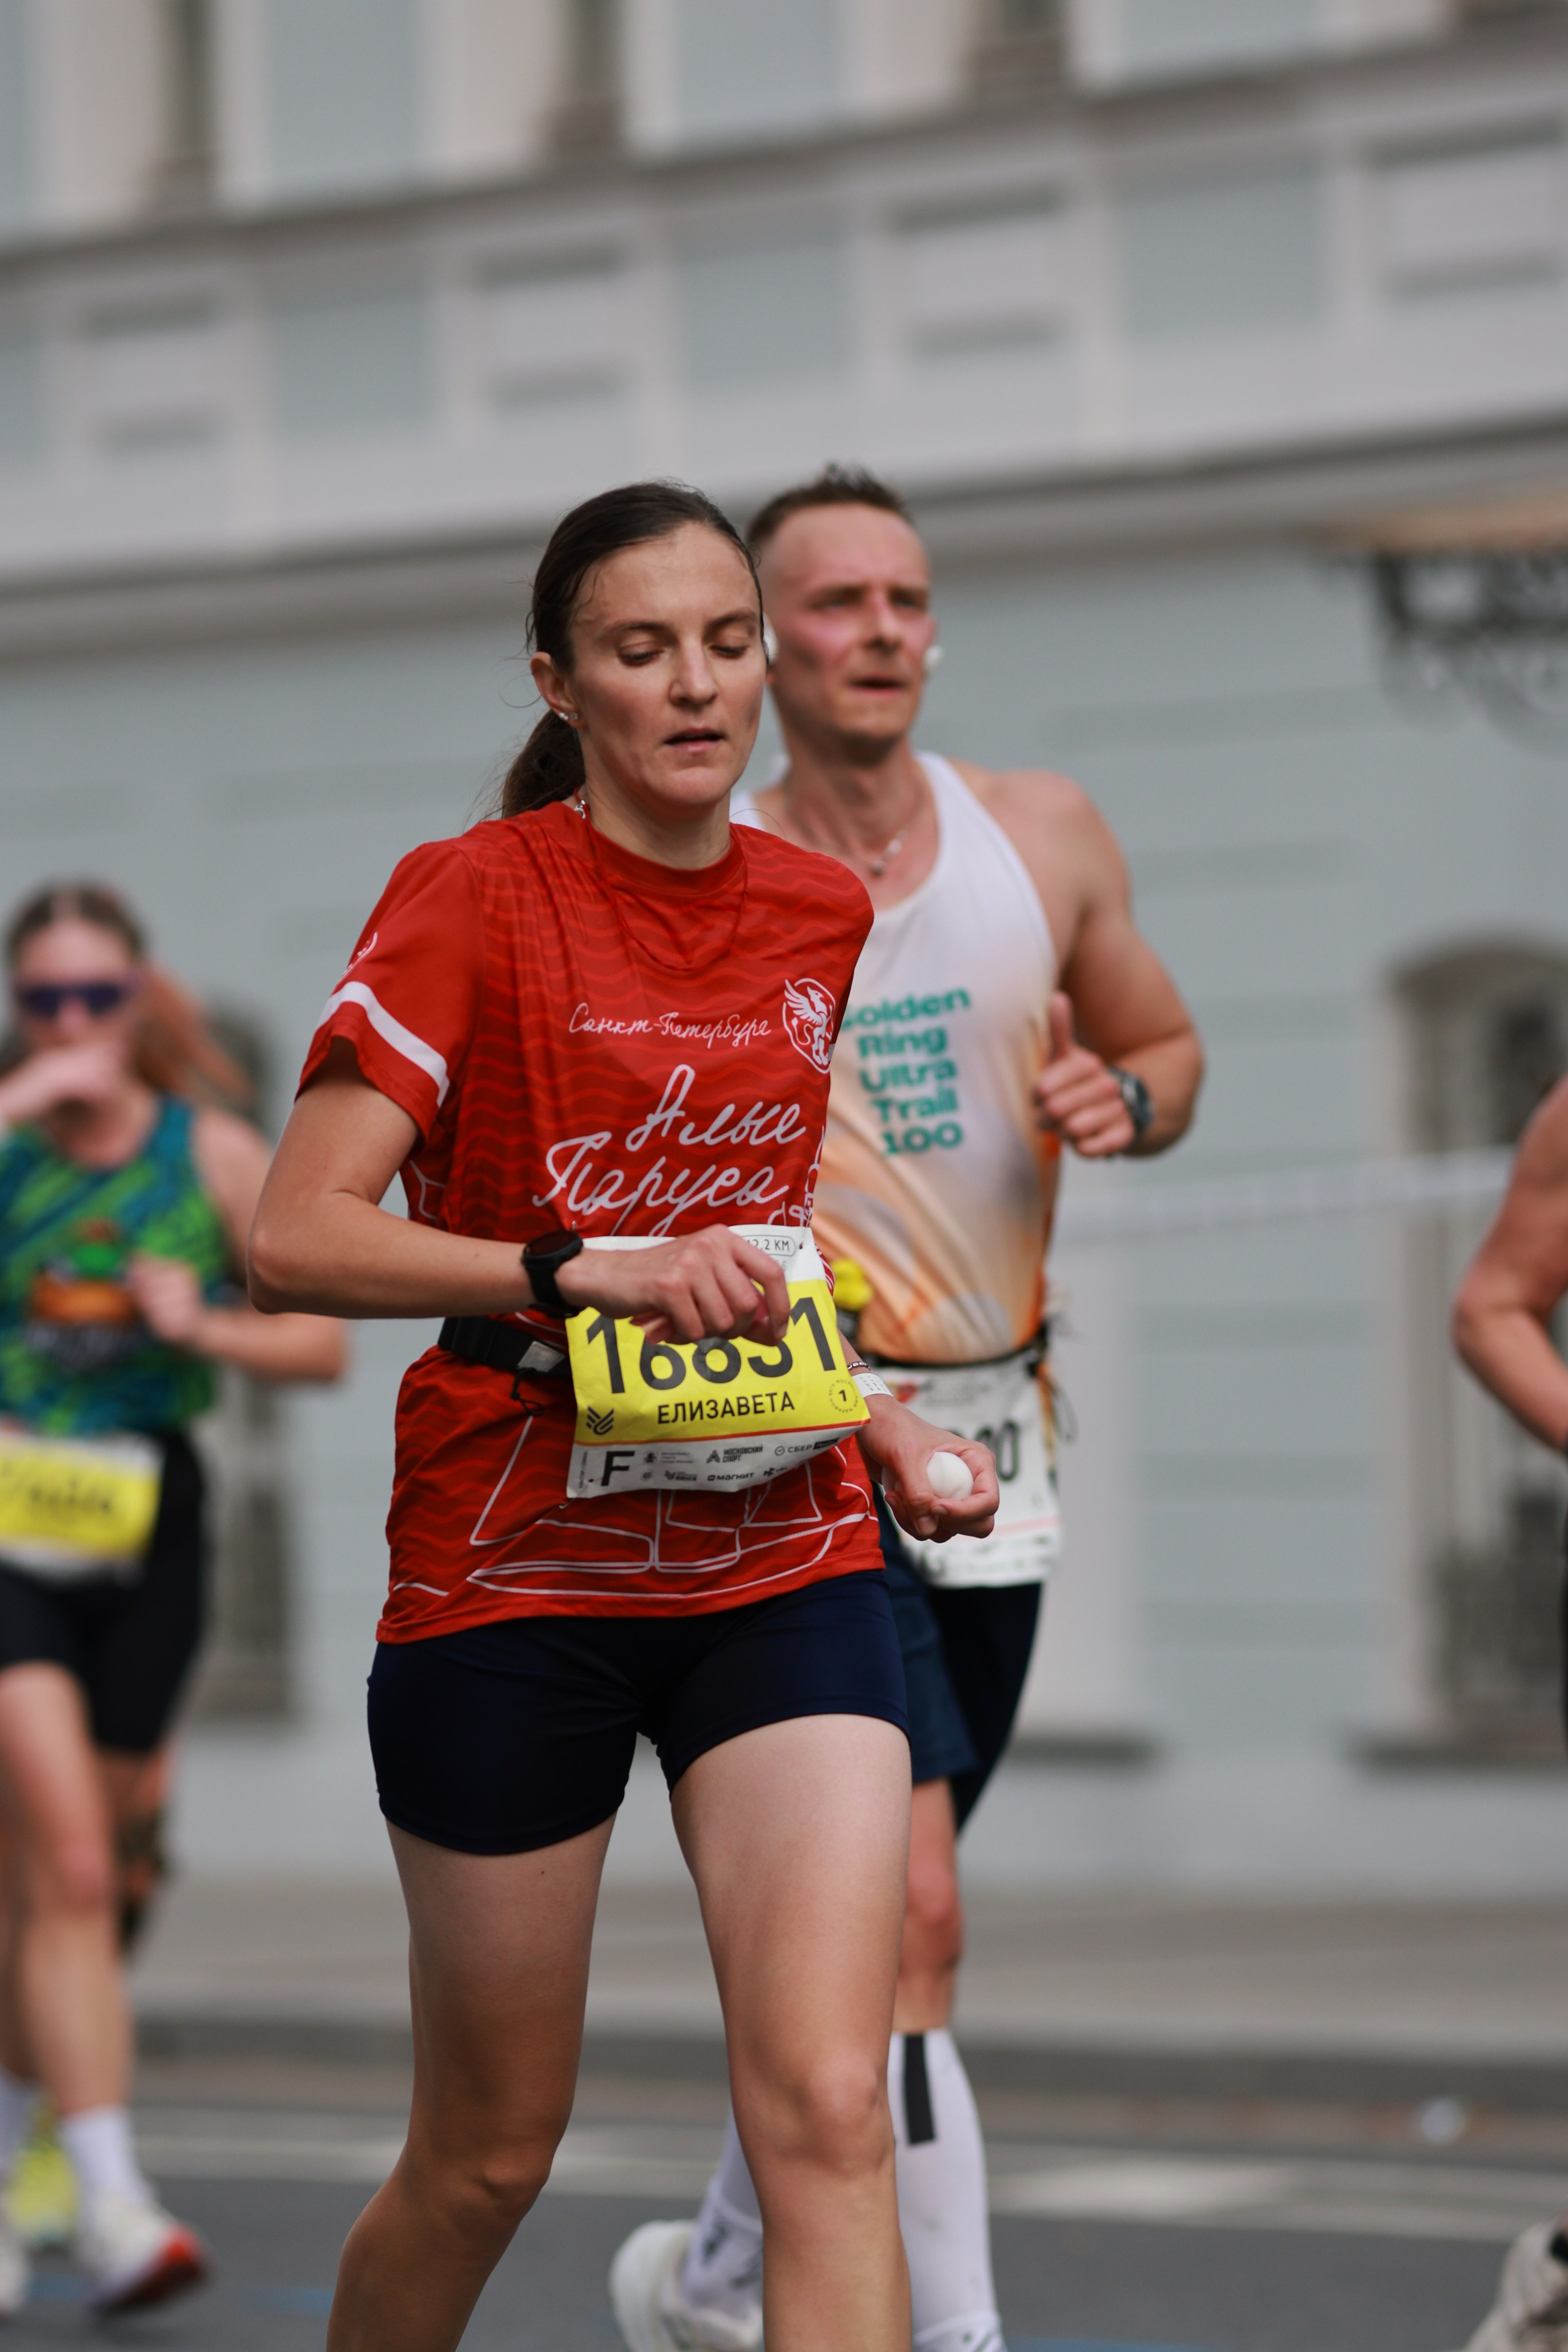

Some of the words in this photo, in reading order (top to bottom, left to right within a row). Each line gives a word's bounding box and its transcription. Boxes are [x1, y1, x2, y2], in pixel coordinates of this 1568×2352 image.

[568, 1002, 771, 1049] Санкт-Петербург
[860, 1059, 957, 1093] Ultra
[625, 1064, 806, 1152] Алые
[870, 1087, 959, 1122] Trail
[883, 1121, 964, 1155] 100
[532, 1131, 790, 1237] Паруса
[747, 1238, 771, 1251] 2,2
[657, 1391, 794, 1424] ЕЛИЗАВЕТА
[839, 1389, 847, 1402] 1
[723, 1444, 763, 1455] МОСКОВСКИЙ
[787, 1444, 812, 1453] СБЕР
[601, 1450, 635, 1487] F
